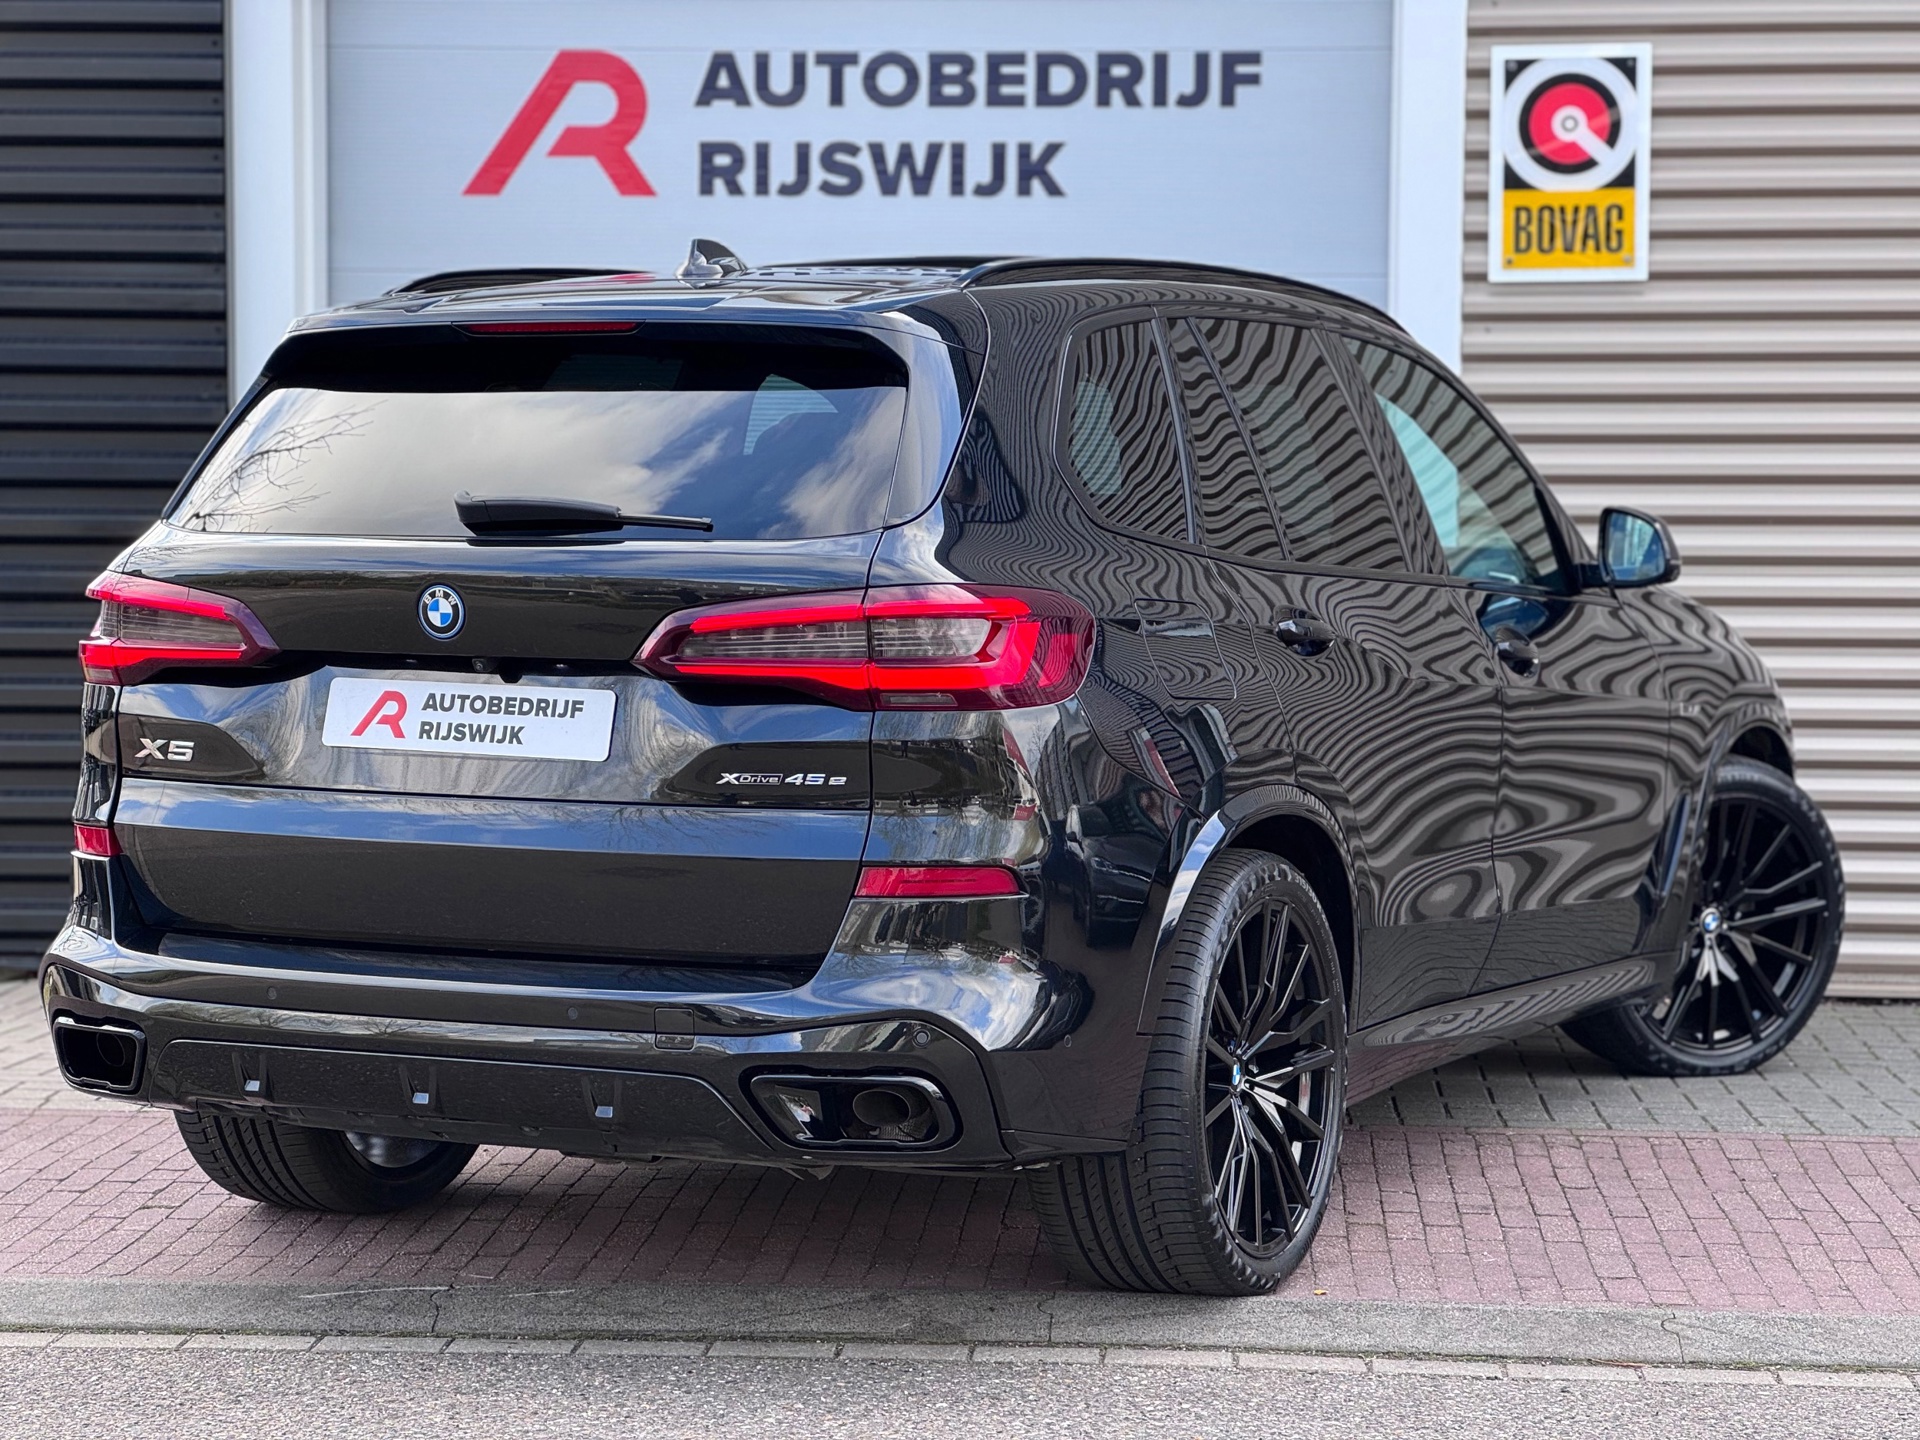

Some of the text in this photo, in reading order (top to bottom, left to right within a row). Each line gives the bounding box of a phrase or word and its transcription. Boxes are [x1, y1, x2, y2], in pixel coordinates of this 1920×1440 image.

[695, 51, 1262, 108] AUTOBEDRIJF
[699, 141, 1065, 197] RIJSWIJK
[1514, 203, 1624, 254] BOVAG
[423, 589, 457, 606] BMW
[421, 692, 585, 719] AUTOBEDRIJF
[418, 720, 525, 745] RIJSWIJK
[134, 737, 195, 762] X5
